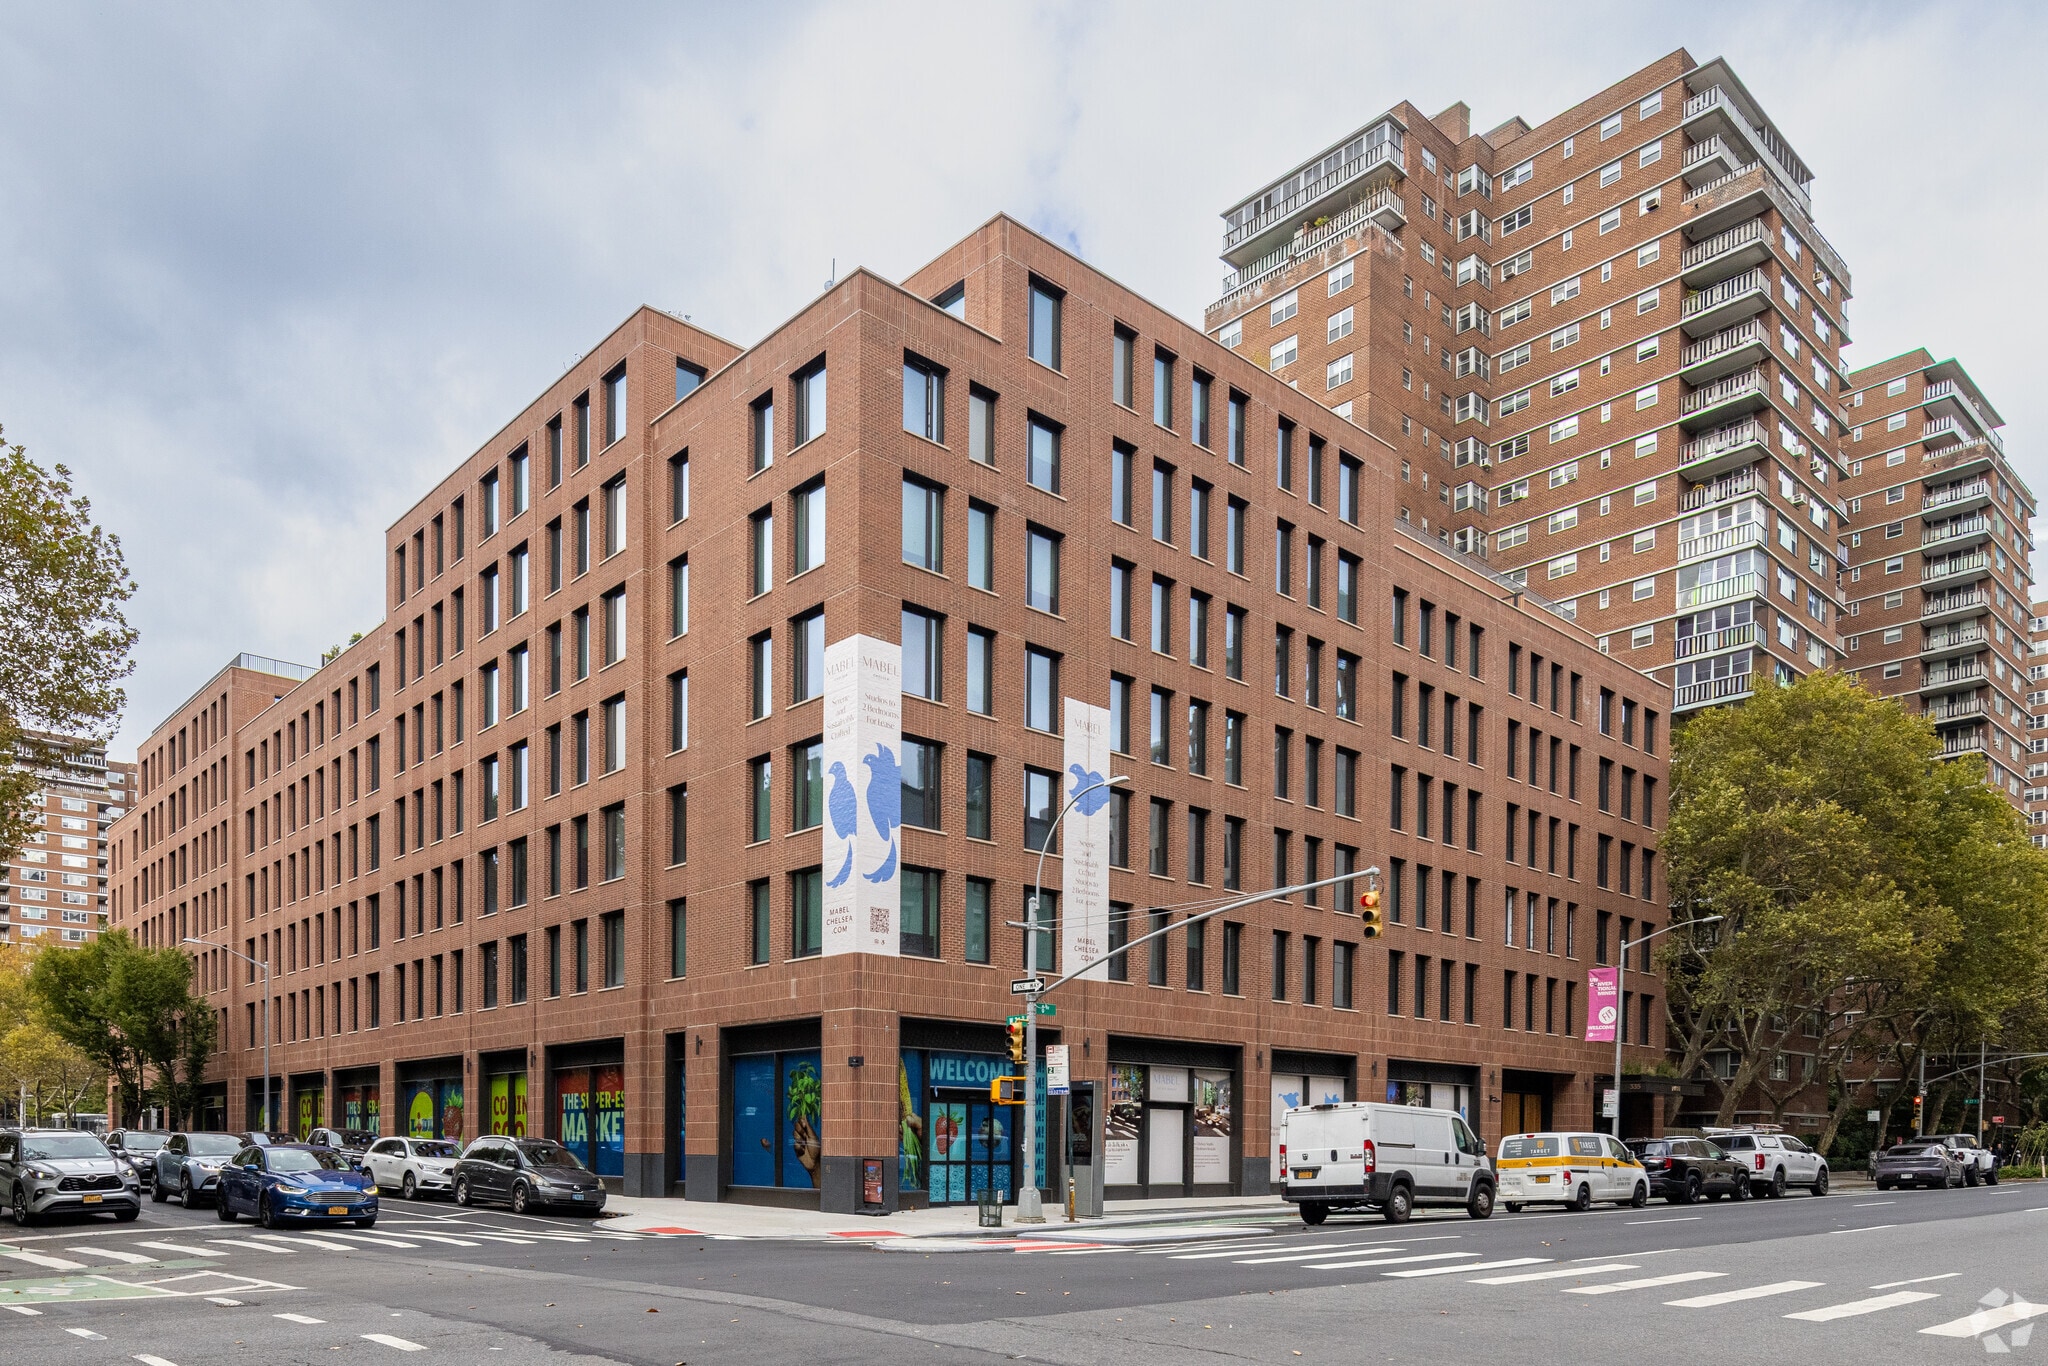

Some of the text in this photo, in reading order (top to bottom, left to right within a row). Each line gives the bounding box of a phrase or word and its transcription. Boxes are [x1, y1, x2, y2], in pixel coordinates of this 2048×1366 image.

[862, 655, 900, 677] MABEL
[864, 692, 888, 705] Studios
[866, 715, 896, 730] For Lease
[829, 906, 850, 916] MABEL
[826, 915, 853, 926] CHELSEA
[832, 926, 848, 935] .COM
[1077, 937, 1096, 946] MABEL
[1073, 945, 1099, 954] CHELSEA
[1601, 1009, 1614, 1021] FIT
[930, 1057, 1014, 1082] WELCOME
[562, 1093, 579, 1110] THE
[1579, 1141, 1597, 1149] TARGET
